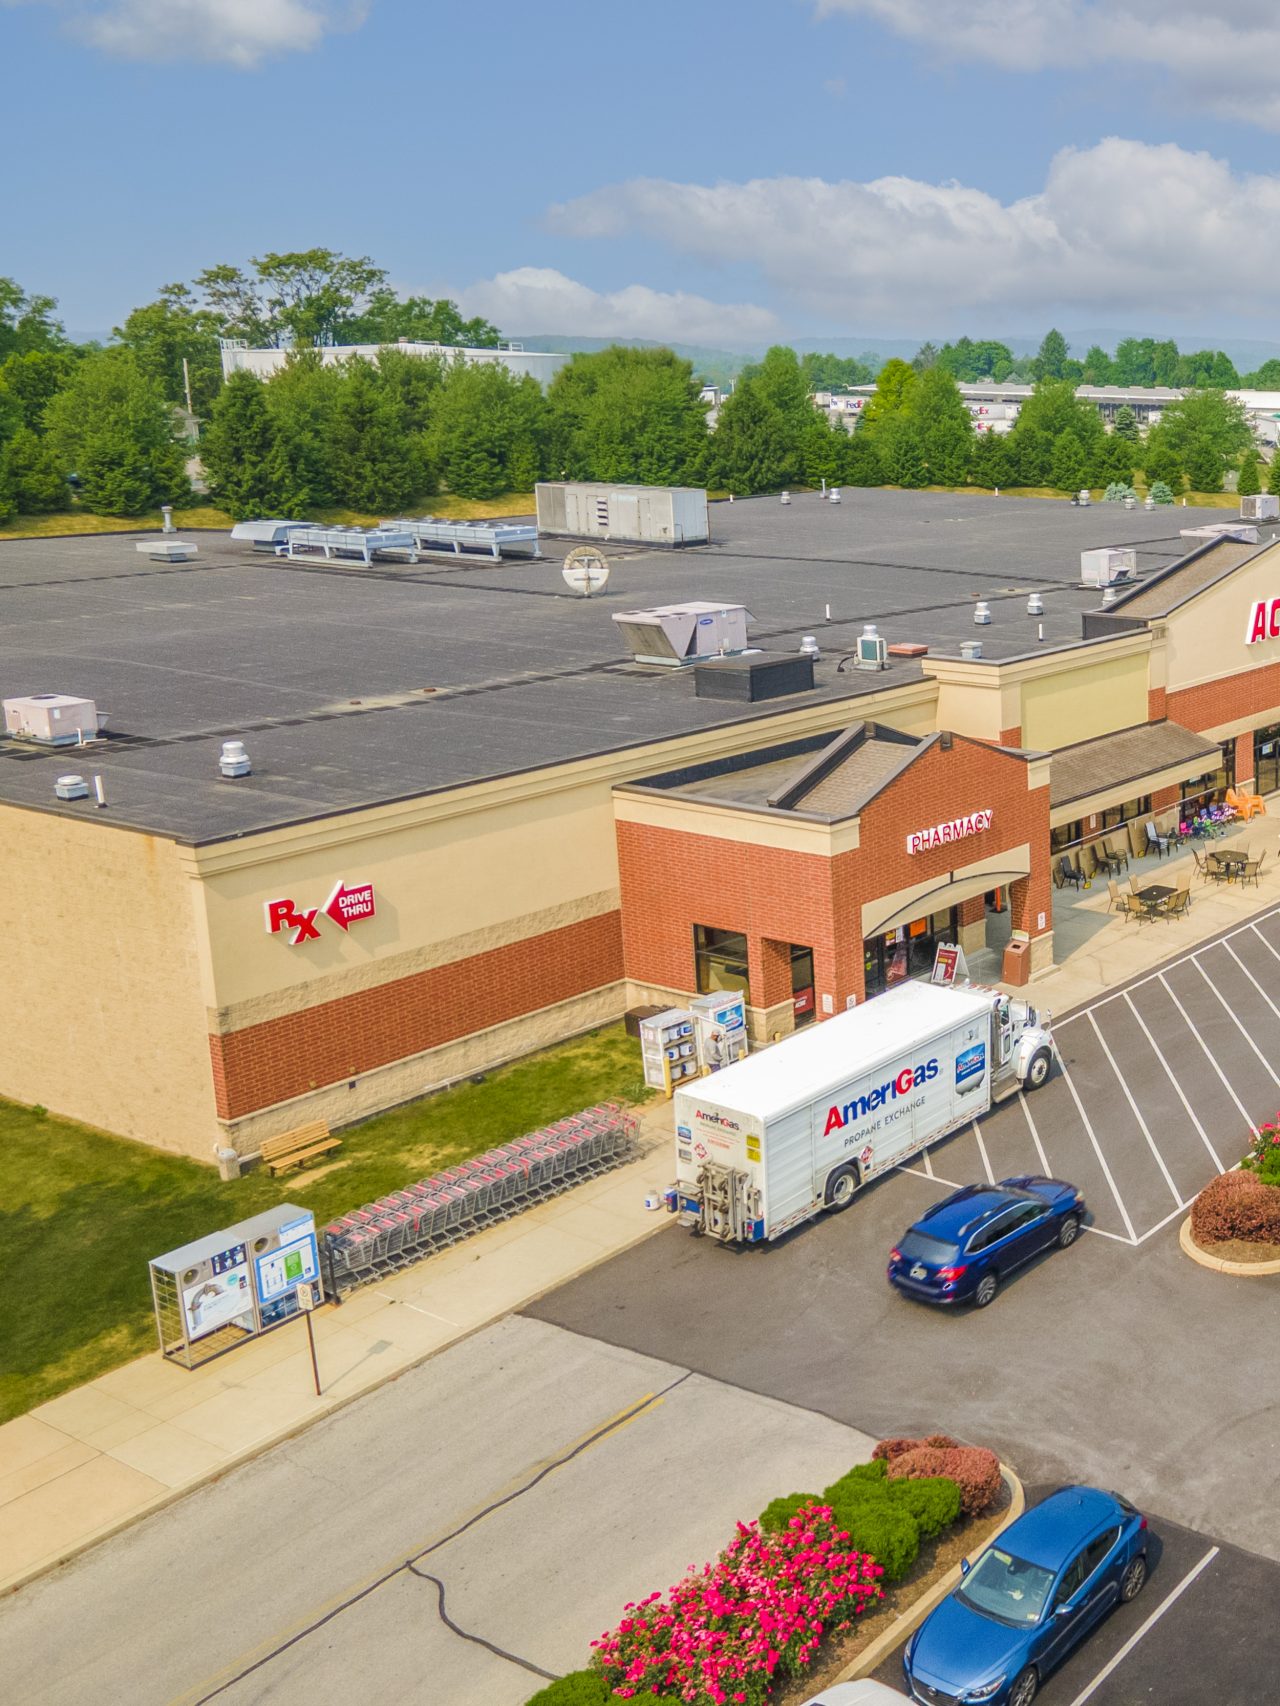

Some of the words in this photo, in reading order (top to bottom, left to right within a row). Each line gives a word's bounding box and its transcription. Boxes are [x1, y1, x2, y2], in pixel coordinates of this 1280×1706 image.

[908, 810, 993, 854] PHARMACY
[338, 889, 372, 908] DRIVE
[341, 901, 372, 918] THRU
[823, 1058, 939, 1137] AmeriGas
[844, 1120, 881, 1148] PROPANE
[885, 1096, 926, 1126] EXCHANGE
